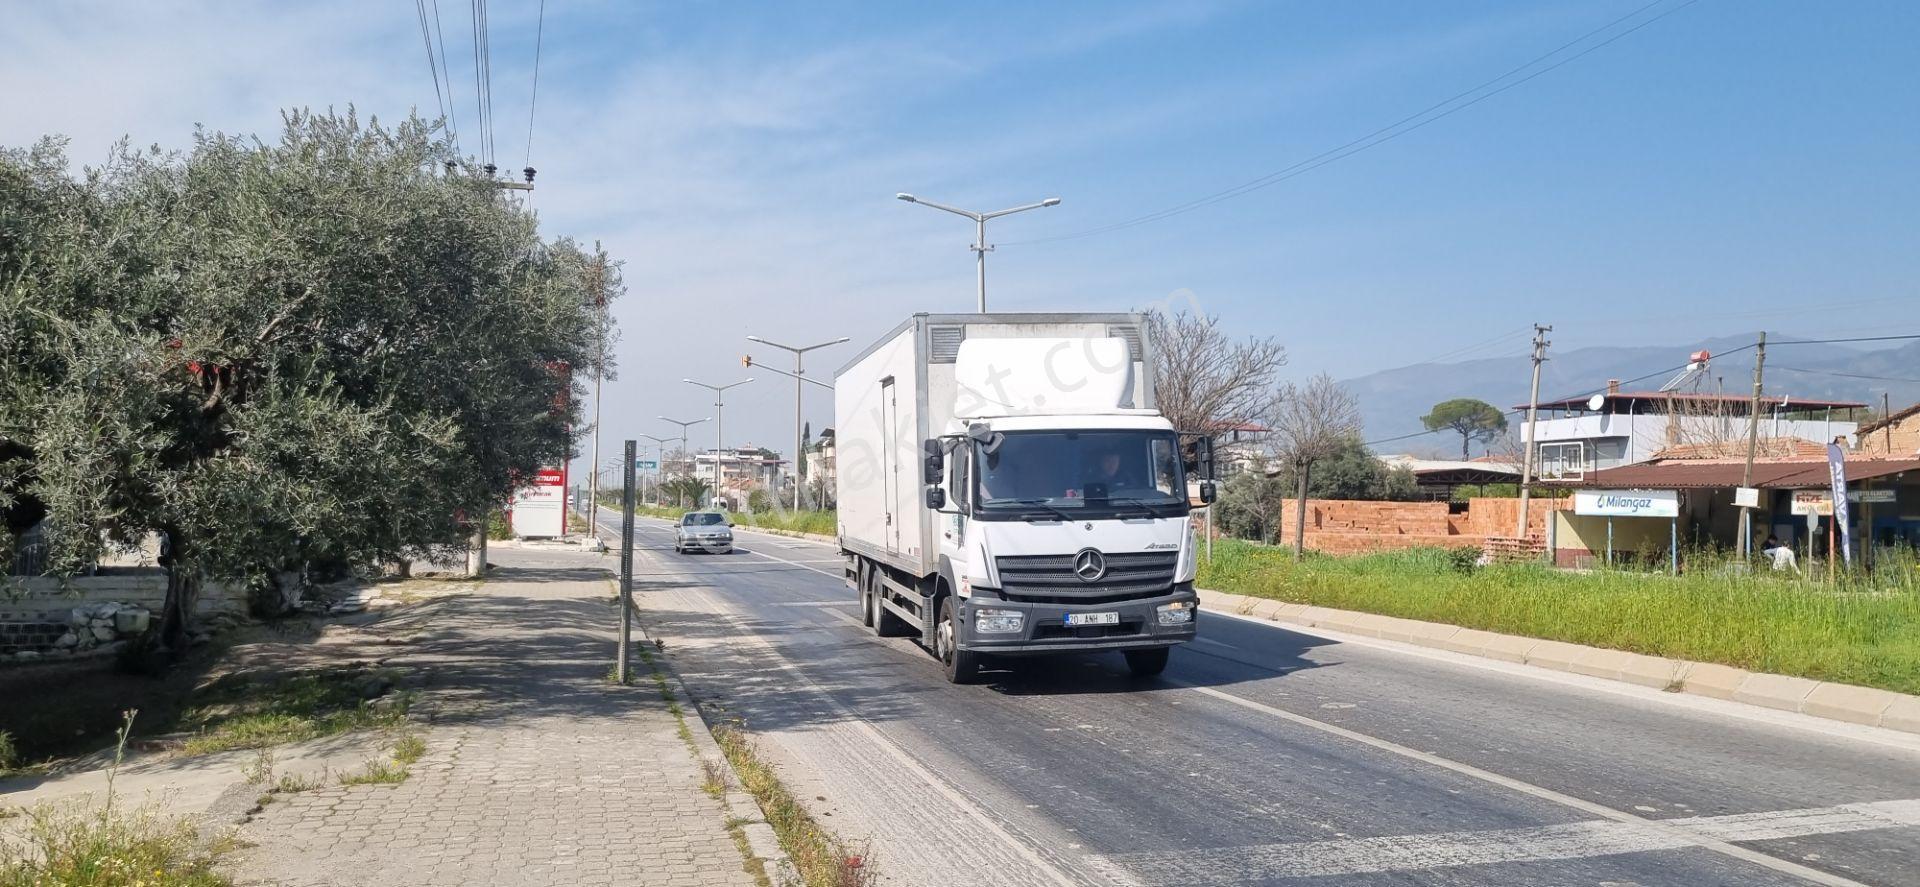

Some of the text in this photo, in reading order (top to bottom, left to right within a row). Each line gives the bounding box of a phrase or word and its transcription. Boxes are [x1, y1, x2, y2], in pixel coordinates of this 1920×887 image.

[1606, 495, 1652, 513] Milangaz
[1069, 615, 1079, 625] 20
[1105, 613, 1118, 623] 187
